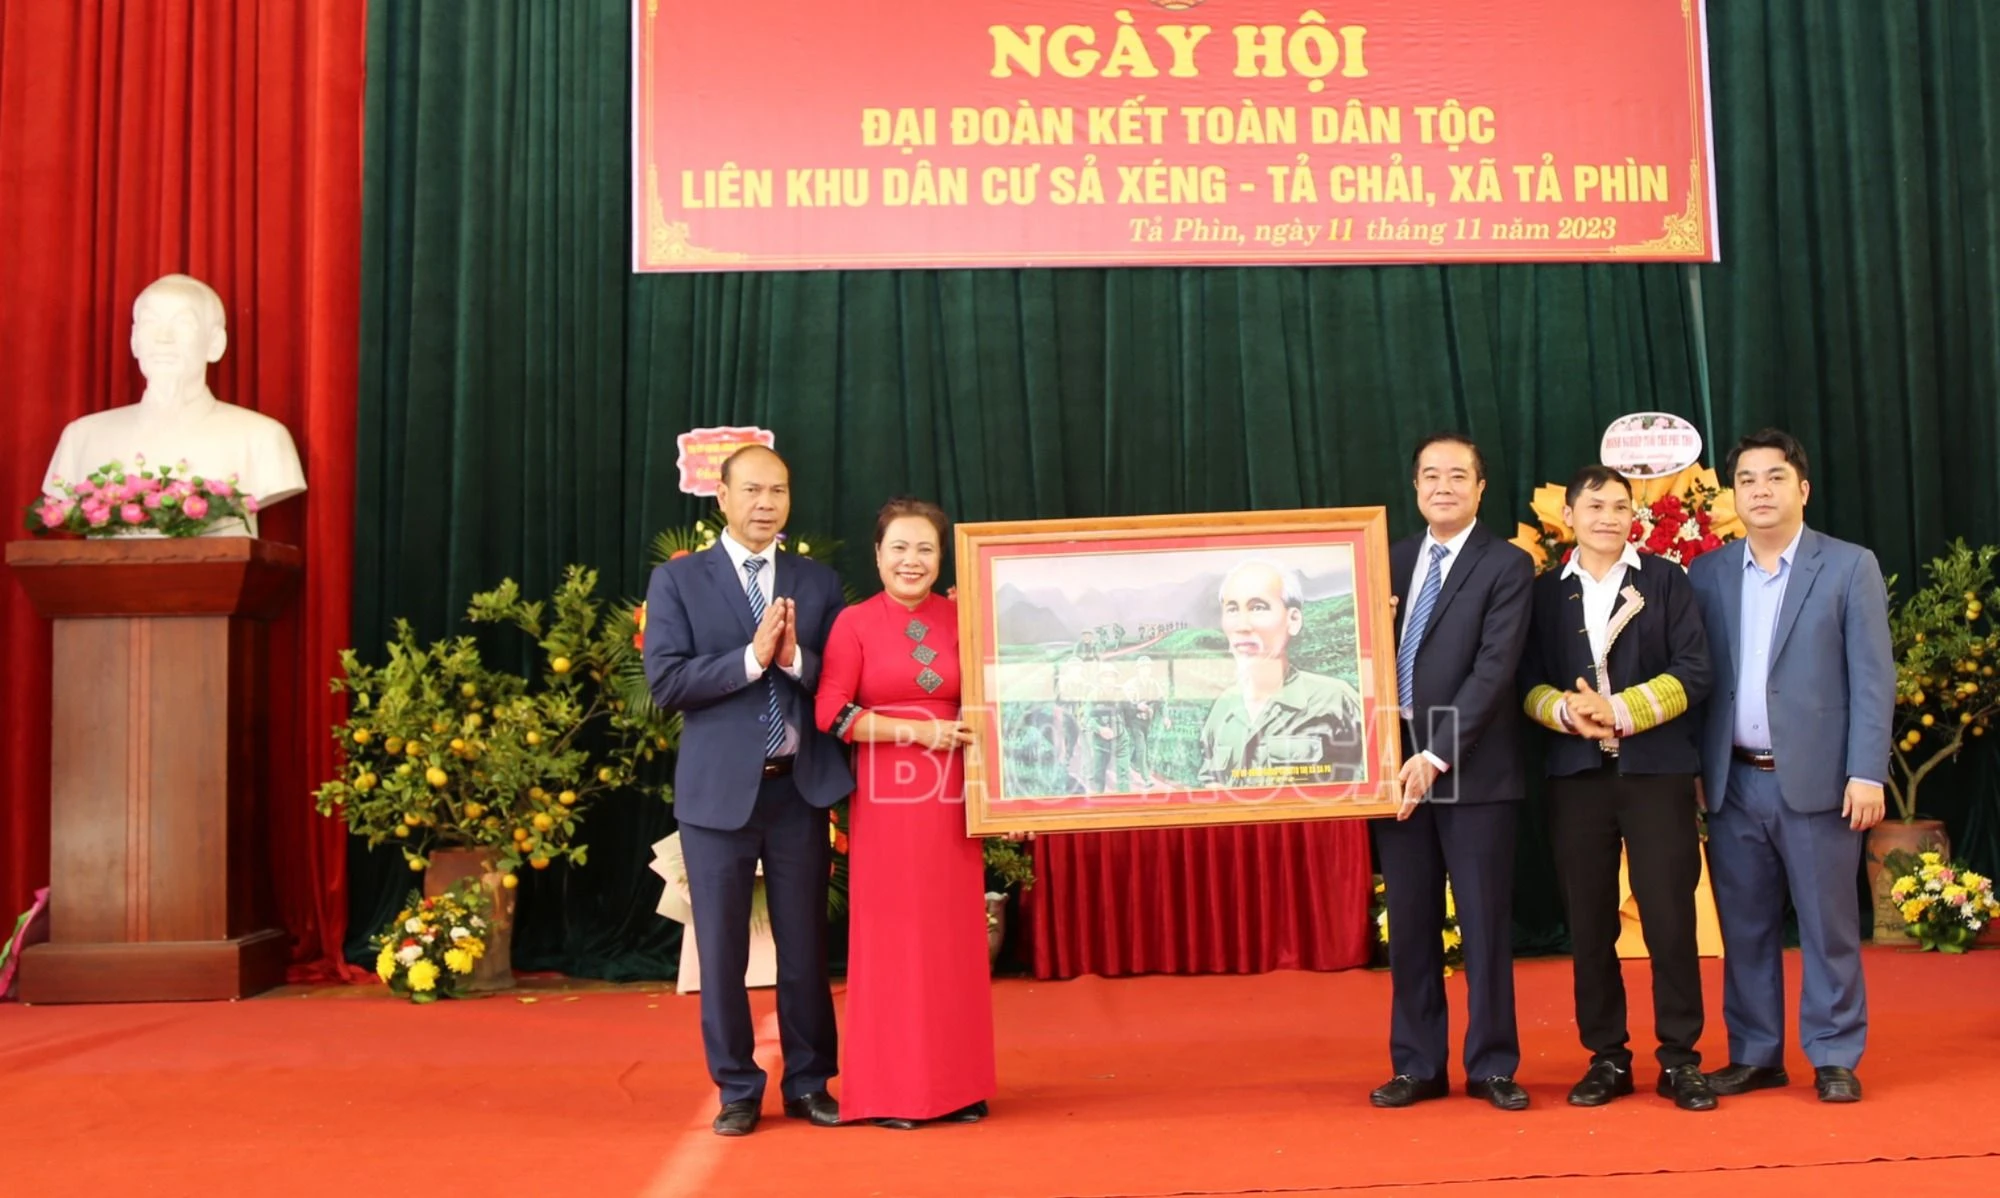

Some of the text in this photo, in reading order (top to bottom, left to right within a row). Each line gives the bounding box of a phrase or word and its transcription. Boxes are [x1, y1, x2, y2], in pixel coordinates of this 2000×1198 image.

[988, 9, 1369, 94] NGÀY HỘI
[861, 94, 1496, 155] ĐẠI ĐOÀN KẾT TOÀN DÂN TỘC
[681, 151, 1669, 209] LIÊN KHU DÂN CƯ SẢ XÉNG - TẢ CHẢI, XÃ TẢ PHÌN
[1129, 215, 1617, 247] Tả Phìn, ngày 11 tháng 11 năm 2023
